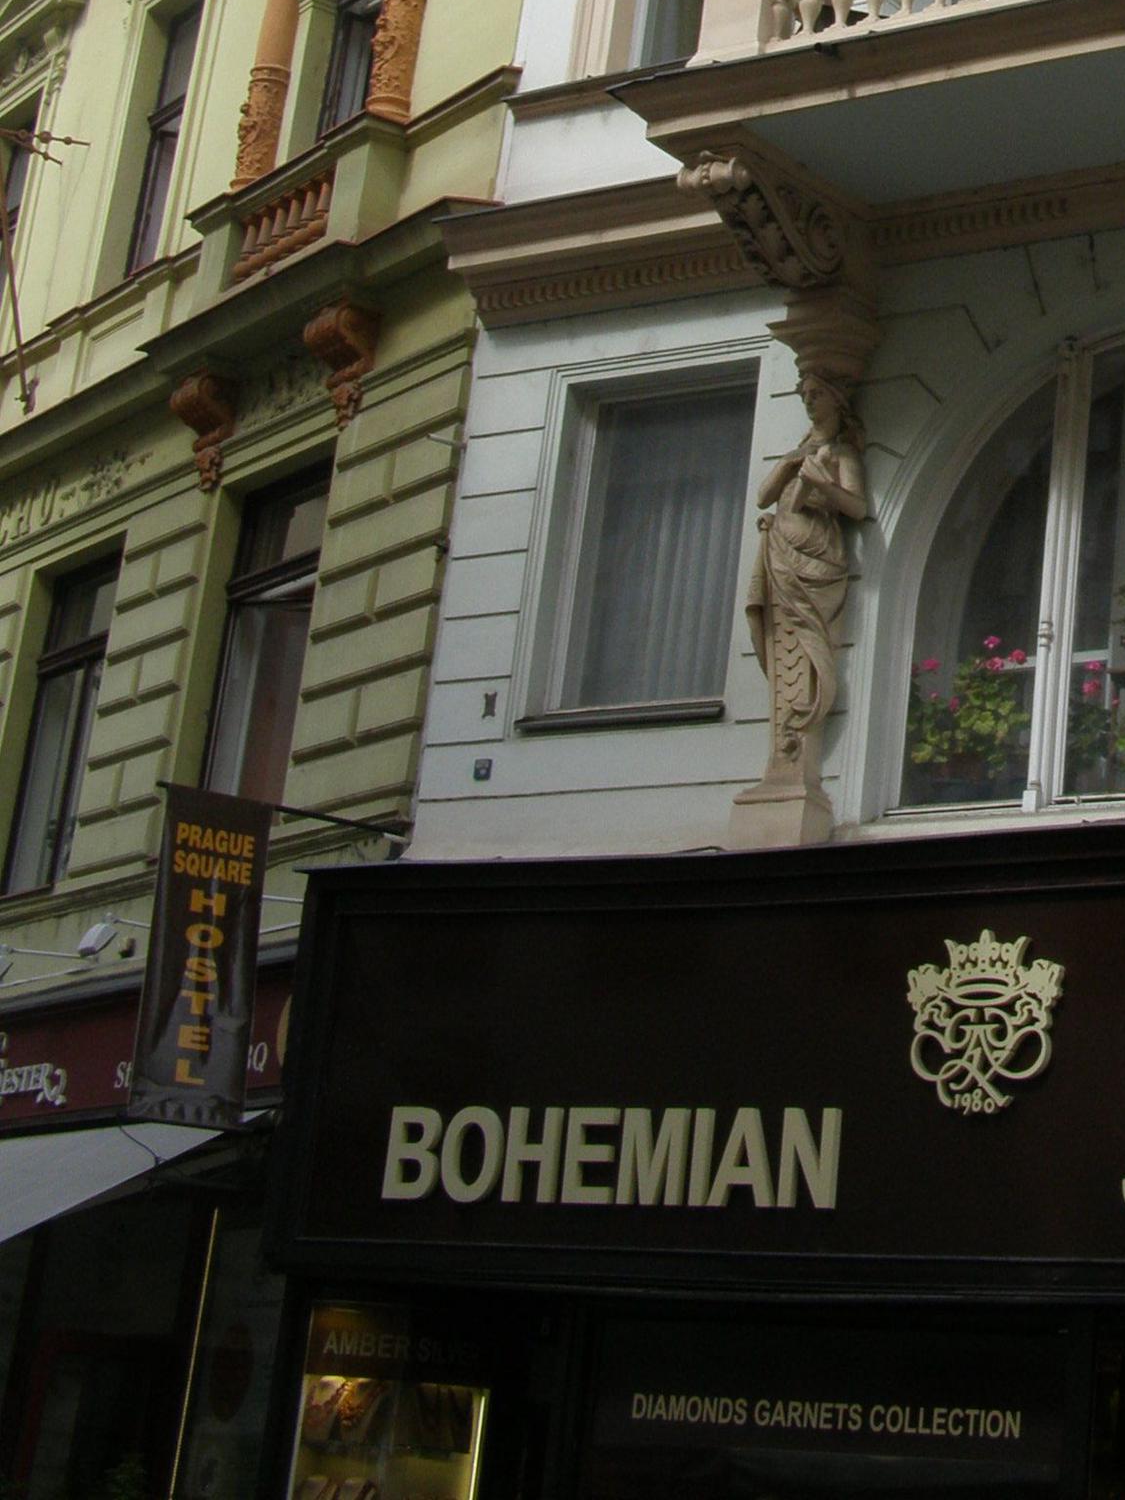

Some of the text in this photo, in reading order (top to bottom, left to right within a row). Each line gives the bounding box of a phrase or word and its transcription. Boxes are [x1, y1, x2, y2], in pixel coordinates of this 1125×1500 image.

[175, 821, 255, 858] PRAGUE
[173, 850, 253, 886] SQUARE
[175, 888, 228, 1087] HOSTEL
[953, 1090, 996, 1116] 1980
[381, 1105, 843, 1209] BOHEMIAN
[322, 1330, 411, 1362] AMBER
[632, 1393, 1021, 1439] DIAMONDS GARNETS COLLECTION
